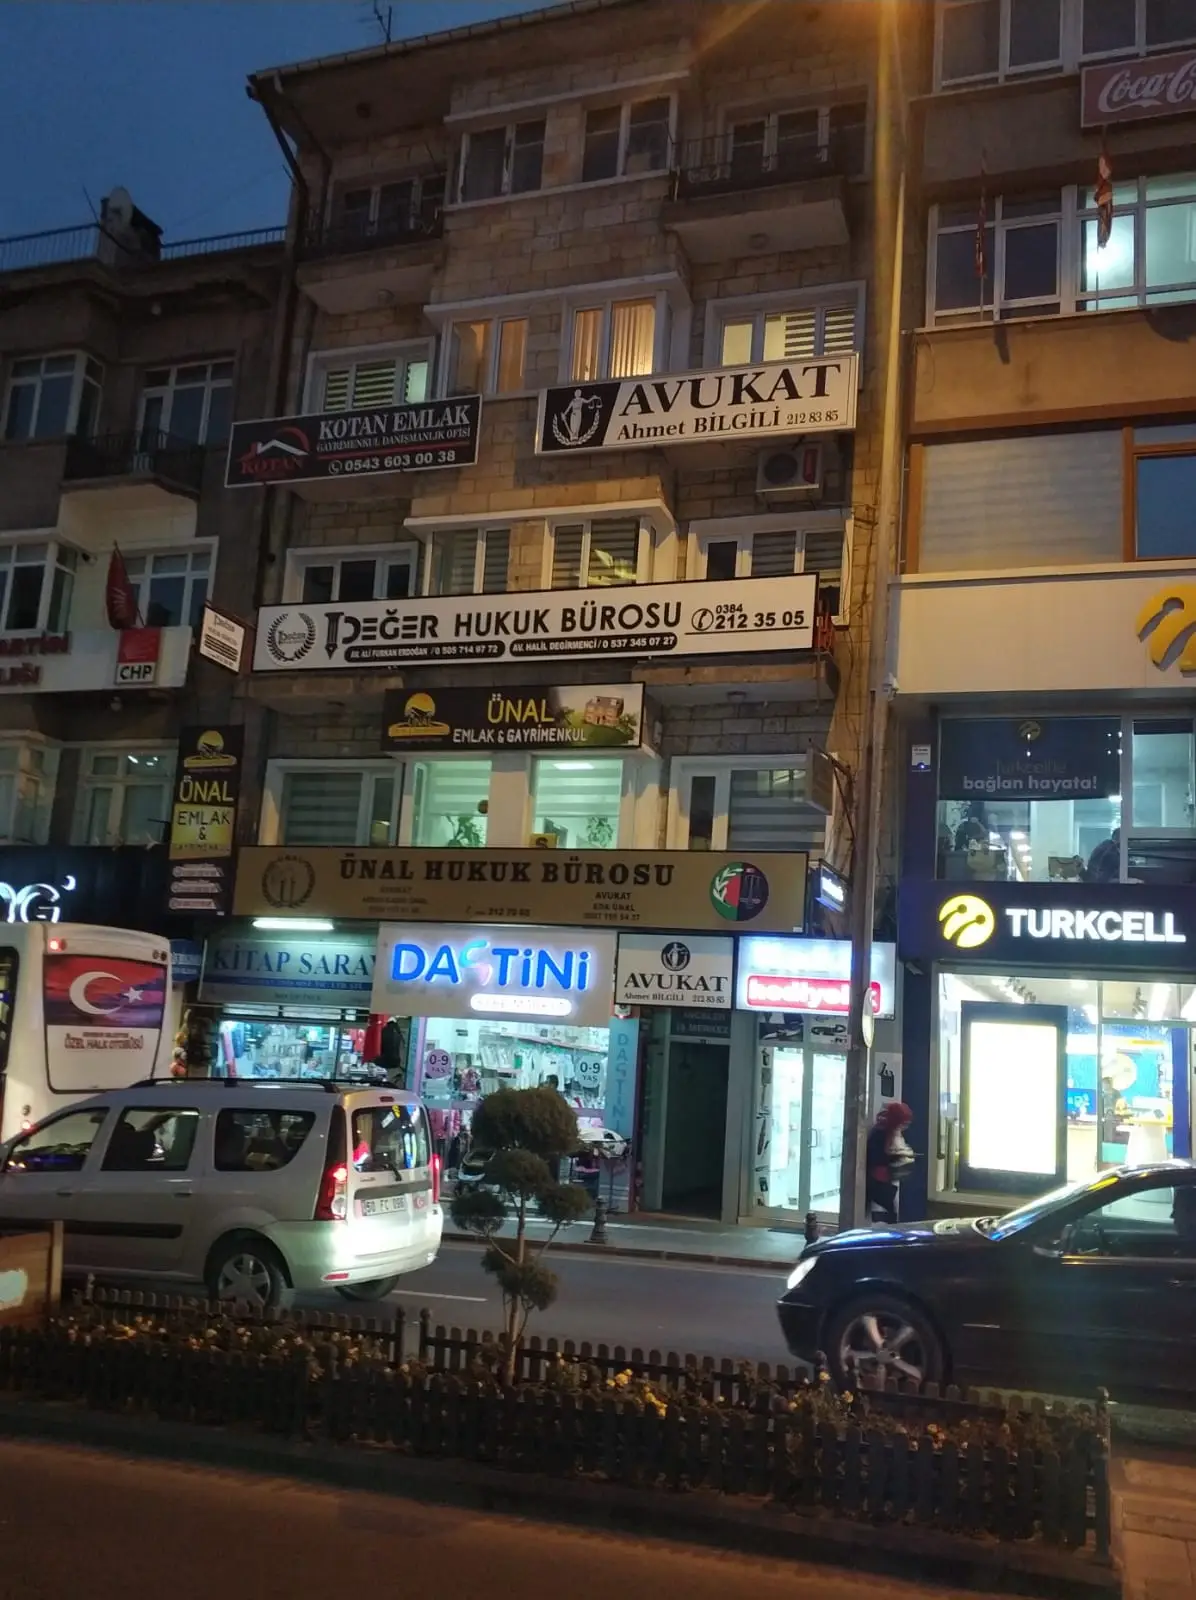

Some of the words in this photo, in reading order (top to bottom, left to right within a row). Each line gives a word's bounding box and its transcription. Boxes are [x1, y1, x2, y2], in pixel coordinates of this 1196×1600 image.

[619, 364, 841, 417] AVUKAT
[319, 414, 390, 440] KOTAN
[392, 405, 471, 433] EMLAK
[617, 422, 685, 441] Ahmet
[692, 406, 781, 434] BİLGİLİ
[786, 412, 808, 426] 212
[808, 410, 823, 423] 83
[825, 409, 839, 423] 85
[344, 459, 380, 472] 0543
[384, 455, 411, 468] 603
[415, 452, 433, 465] 00
[437, 450, 456, 463] 38
[715, 603, 743, 614] 0384
[341, 609, 440, 645] DEĞER
[454, 608, 551, 637] HUKUK
[560, 601, 683, 634] BÜROSU
[715, 614, 748, 630] 212
[754, 612, 776, 628] 35
[782, 610, 805, 626] 05
[611, 639, 627, 648] 537
[630, 638, 646, 647] 345
[649, 637, 660, 646] 07
[663, 636, 675, 645] 27
[120, 665, 153, 680] CHP
[487, 693, 555, 723] ÜNAL
[453, 728, 495, 743] EMLAK
[507, 724, 588, 743] GAYRİMENKUL
[179, 775, 234, 802] ÜNAL
[963, 776, 1023, 792] bağlan
[1028, 776, 1097, 792] hayata!
[177, 810, 231, 826] EMLAK
[198, 826, 207, 841] &
[340, 853, 414, 880] ÜNAL
[425, 860, 531, 883] HUKUK
[541, 856, 675, 886] BÜROSU
[595, 891, 632, 900] AVUKAT
[1005, 908, 1186, 943] TURKCELL
[214, 944, 290, 973] KİTAP
[624, 972, 728, 992] AVUKAT
[429, 1054, 449, 1066] 0-9
[580, 1062, 600, 1074] 0-9
